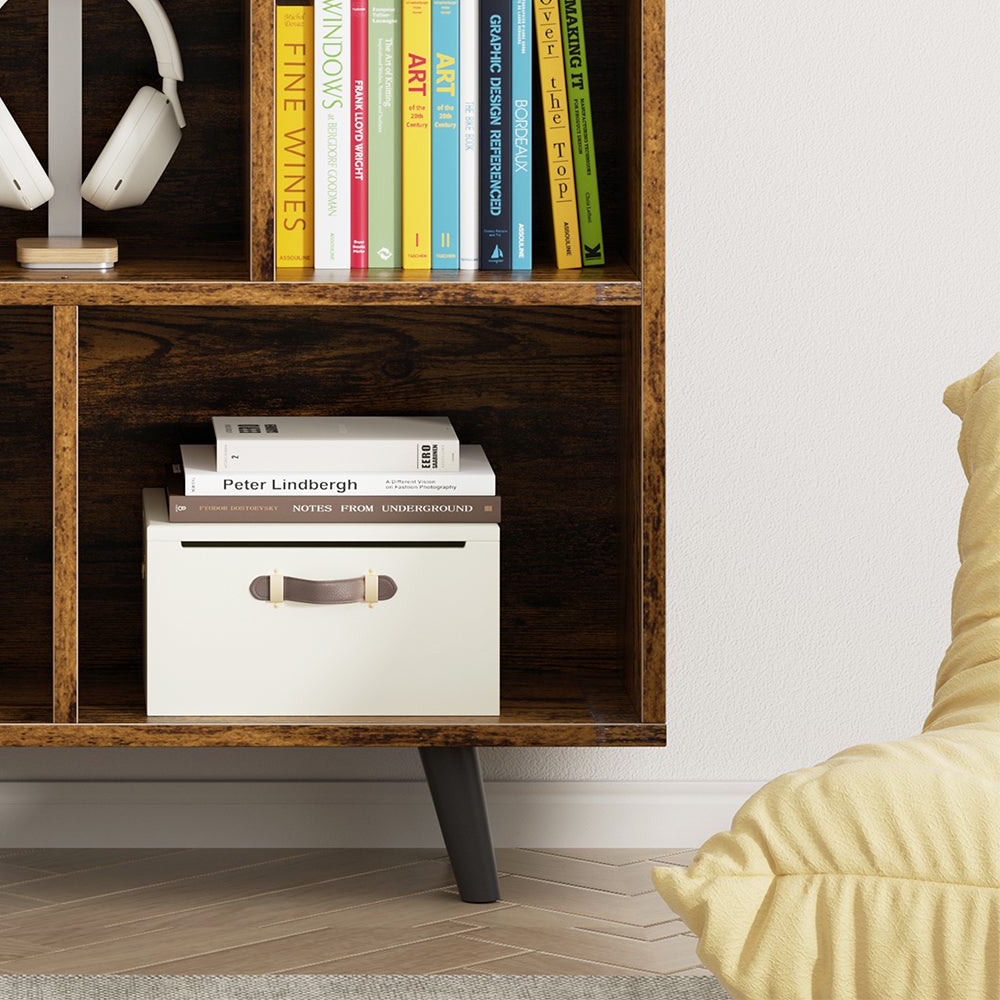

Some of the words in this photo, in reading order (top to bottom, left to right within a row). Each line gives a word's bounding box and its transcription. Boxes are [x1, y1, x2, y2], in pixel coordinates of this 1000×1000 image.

[384, 38, 393, 52] The
[384, 53, 393, 66] Art
[489, 14, 502, 74] GRAPHIC
[283, 42, 306, 112] FINE
[354, 80, 364, 110] FRANK
[407, 53, 427, 96] ART
[435, 52, 455, 96] ART
[571, 74, 584, 90] IT
[489, 77, 502, 126] DESIGN
[549, 77, 562, 125] the
[328, 122, 338, 167] BERGDORF
[354, 112, 364, 141] LLOYD
[514, 99, 528, 173] BORDEAUX
[283, 127, 306, 232] WINES
[354, 142, 364, 181] WRIGHT
[489, 129, 502, 216] REFERENCED
[553, 142, 568, 199] Top
[328, 168, 338, 217] GOODMAN
[563, 221, 572, 256] ASSOULINE
[421, 445, 431, 469] EERO
[223, 478, 267, 490] Peter
[272, 478, 357, 493] Lindbergh
[292, 504, 333, 512] NOTES
[340, 504, 375, 512] FROM
[381, 504, 473, 512] UNDERGROUND
